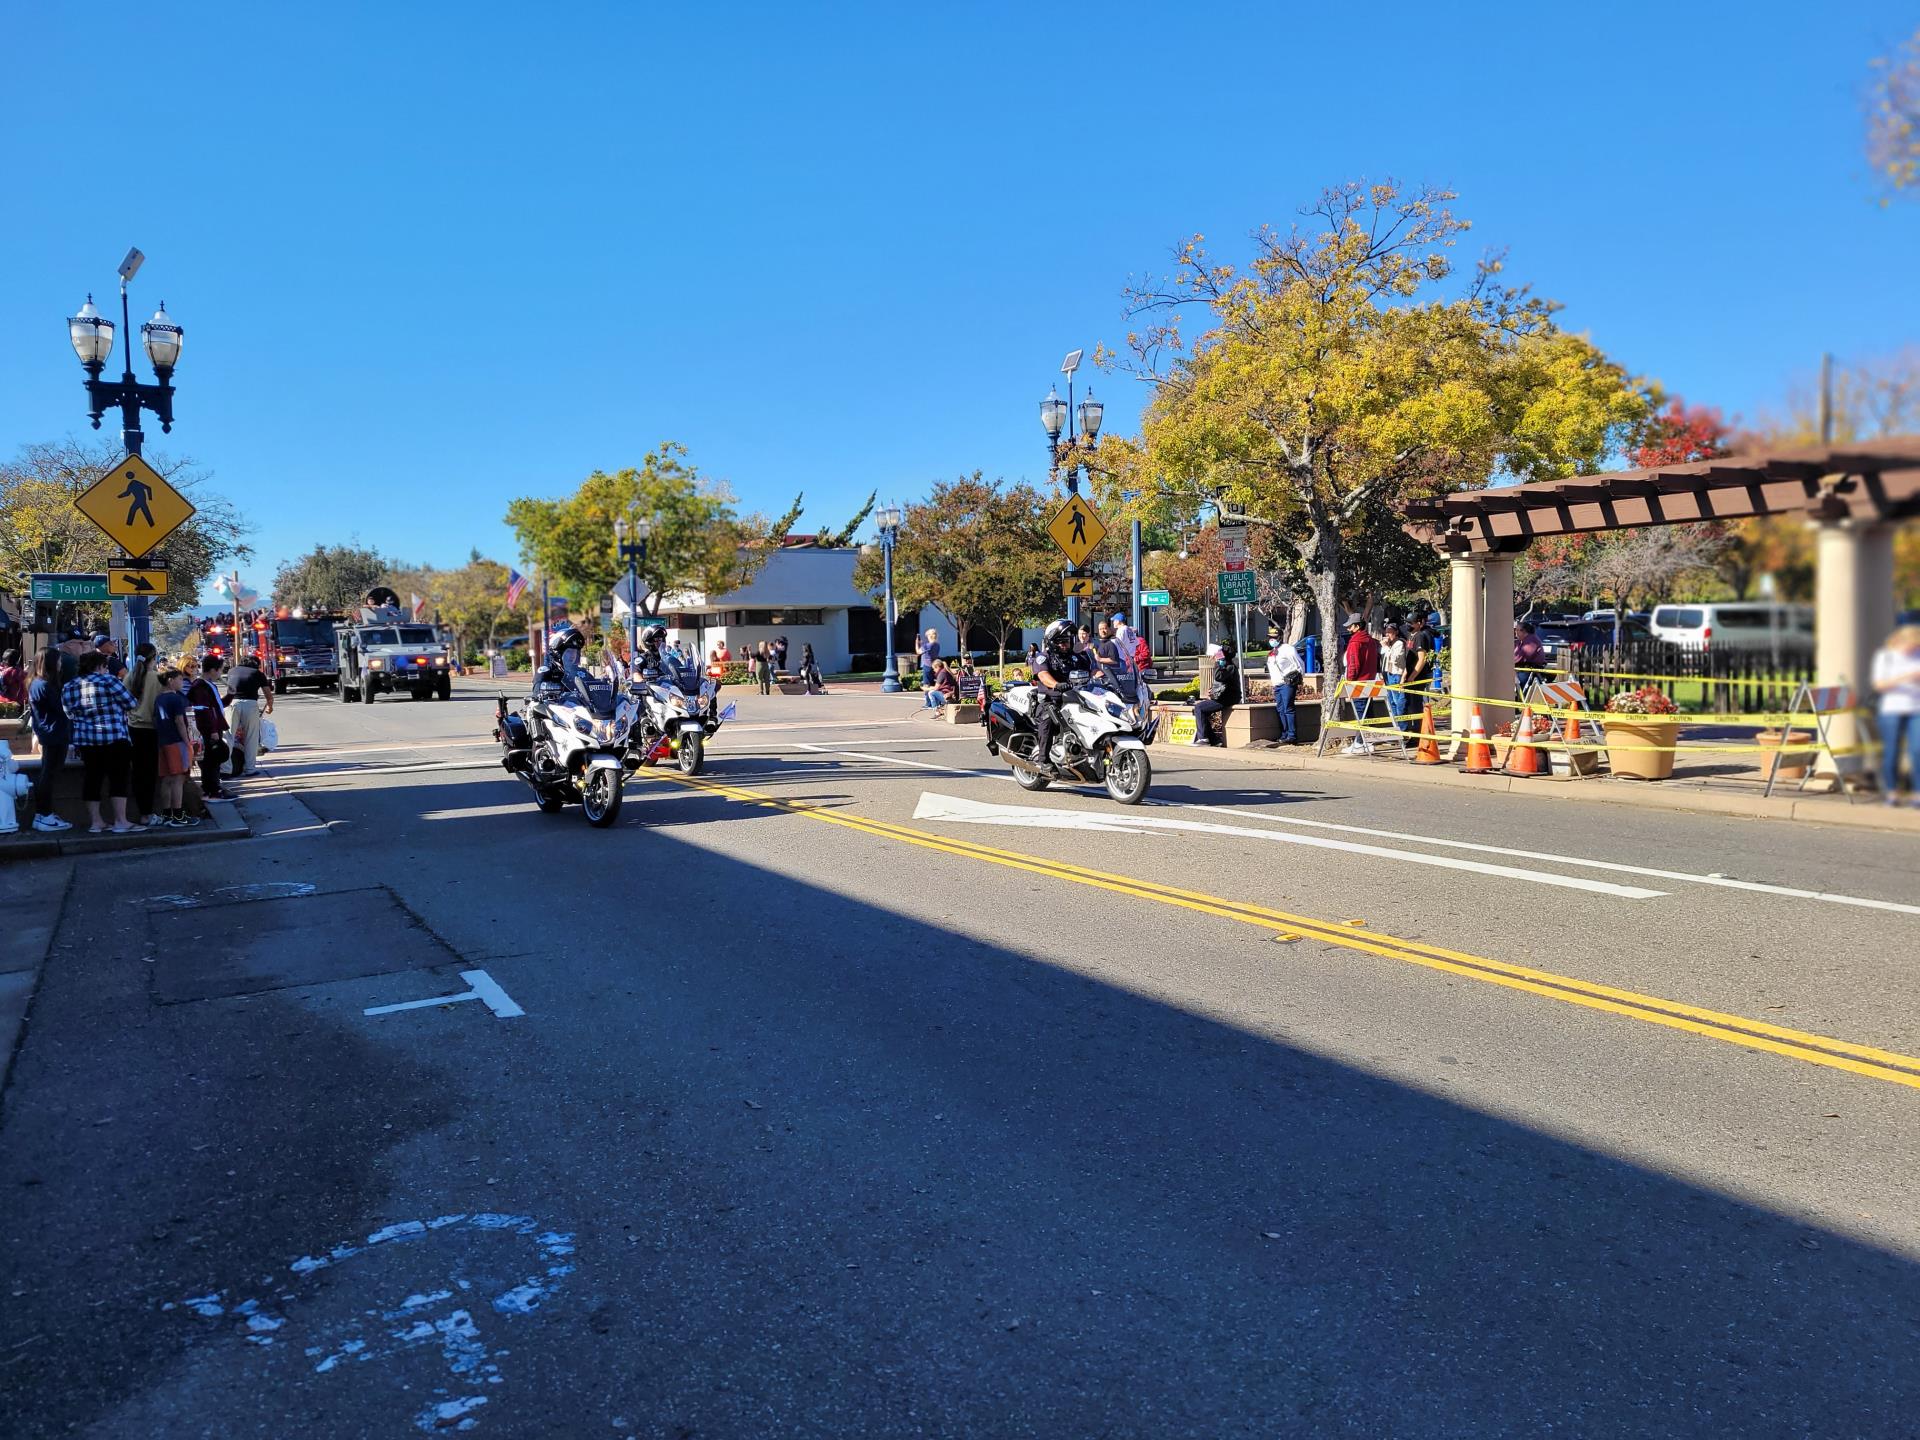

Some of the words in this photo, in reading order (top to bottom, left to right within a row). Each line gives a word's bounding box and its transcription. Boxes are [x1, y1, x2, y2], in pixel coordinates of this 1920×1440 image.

[1223, 573, 1249, 581] PUBLIC
[59, 584, 95, 595] Taylor
[1221, 581, 1251, 590] LIBRARY
[1233, 588, 1252, 596] BLKS
[1584, 712, 1606, 720] CAUTION
[1669, 714, 1693, 722] CAUTION
[1171, 728, 1195, 736] LORD
